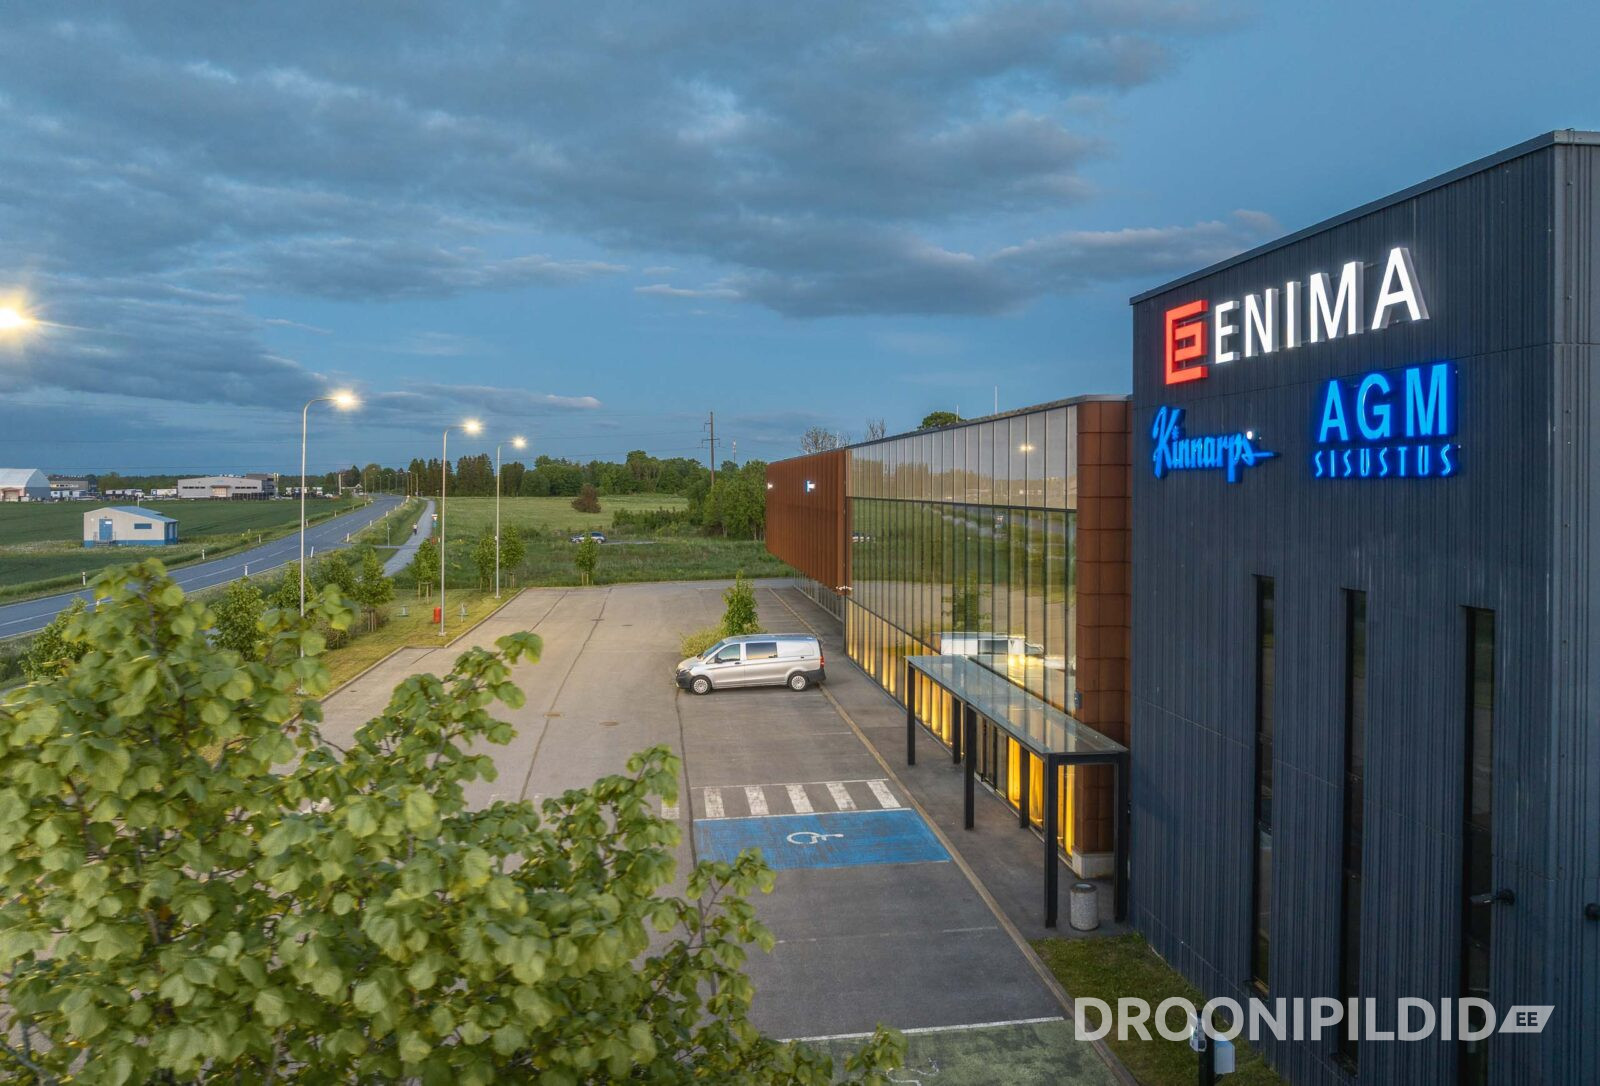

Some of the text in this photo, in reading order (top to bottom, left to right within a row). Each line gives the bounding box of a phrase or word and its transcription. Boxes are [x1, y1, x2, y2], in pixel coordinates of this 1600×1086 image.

[1215, 247, 1429, 364] ENIMA
[1319, 363, 1449, 443] AGM
[1152, 405, 1276, 482] Kinnarps
[1315, 444, 1452, 477] SISUSTUS
